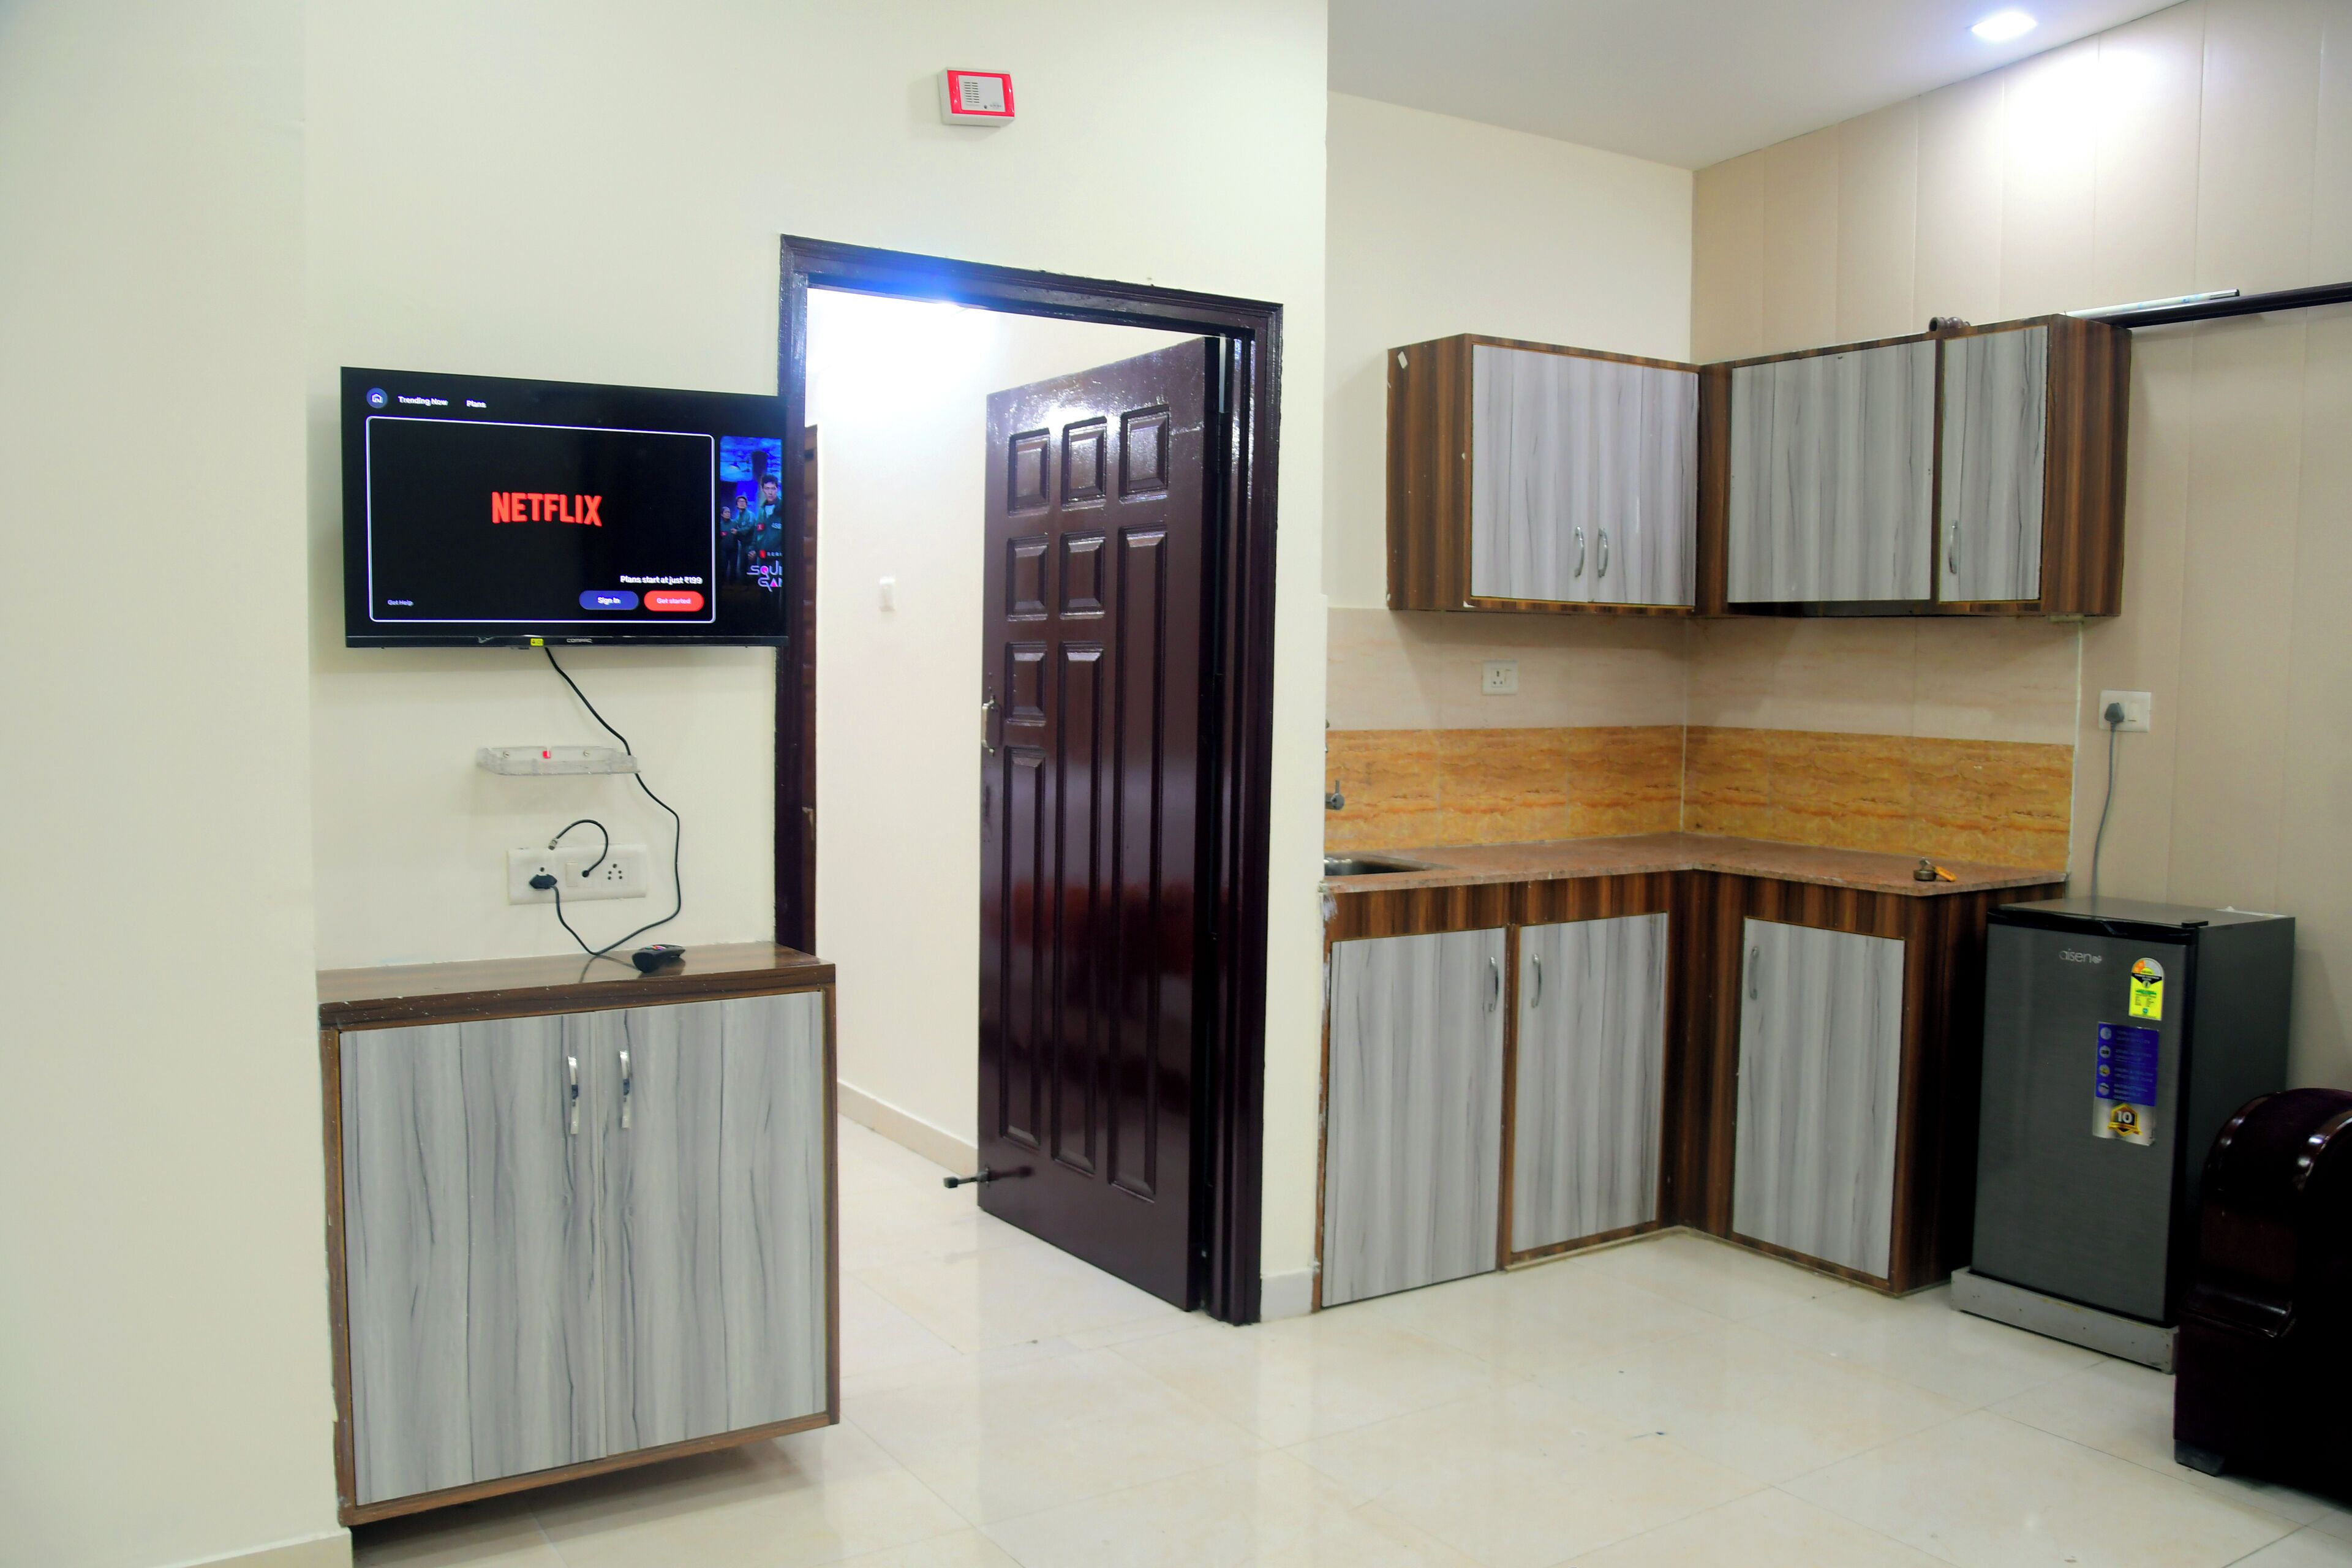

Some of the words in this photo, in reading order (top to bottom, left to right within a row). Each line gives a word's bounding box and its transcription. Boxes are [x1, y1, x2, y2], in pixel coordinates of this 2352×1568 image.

[398, 396, 431, 406] Trending
[492, 492, 602, 527] NETFLIX
[668, 576, 684, 585] just
[598, 597, 612, 605] Sign
[2058, 948, 2092, 963] aisen
[2116, 1110, 2132, 1123] 10
